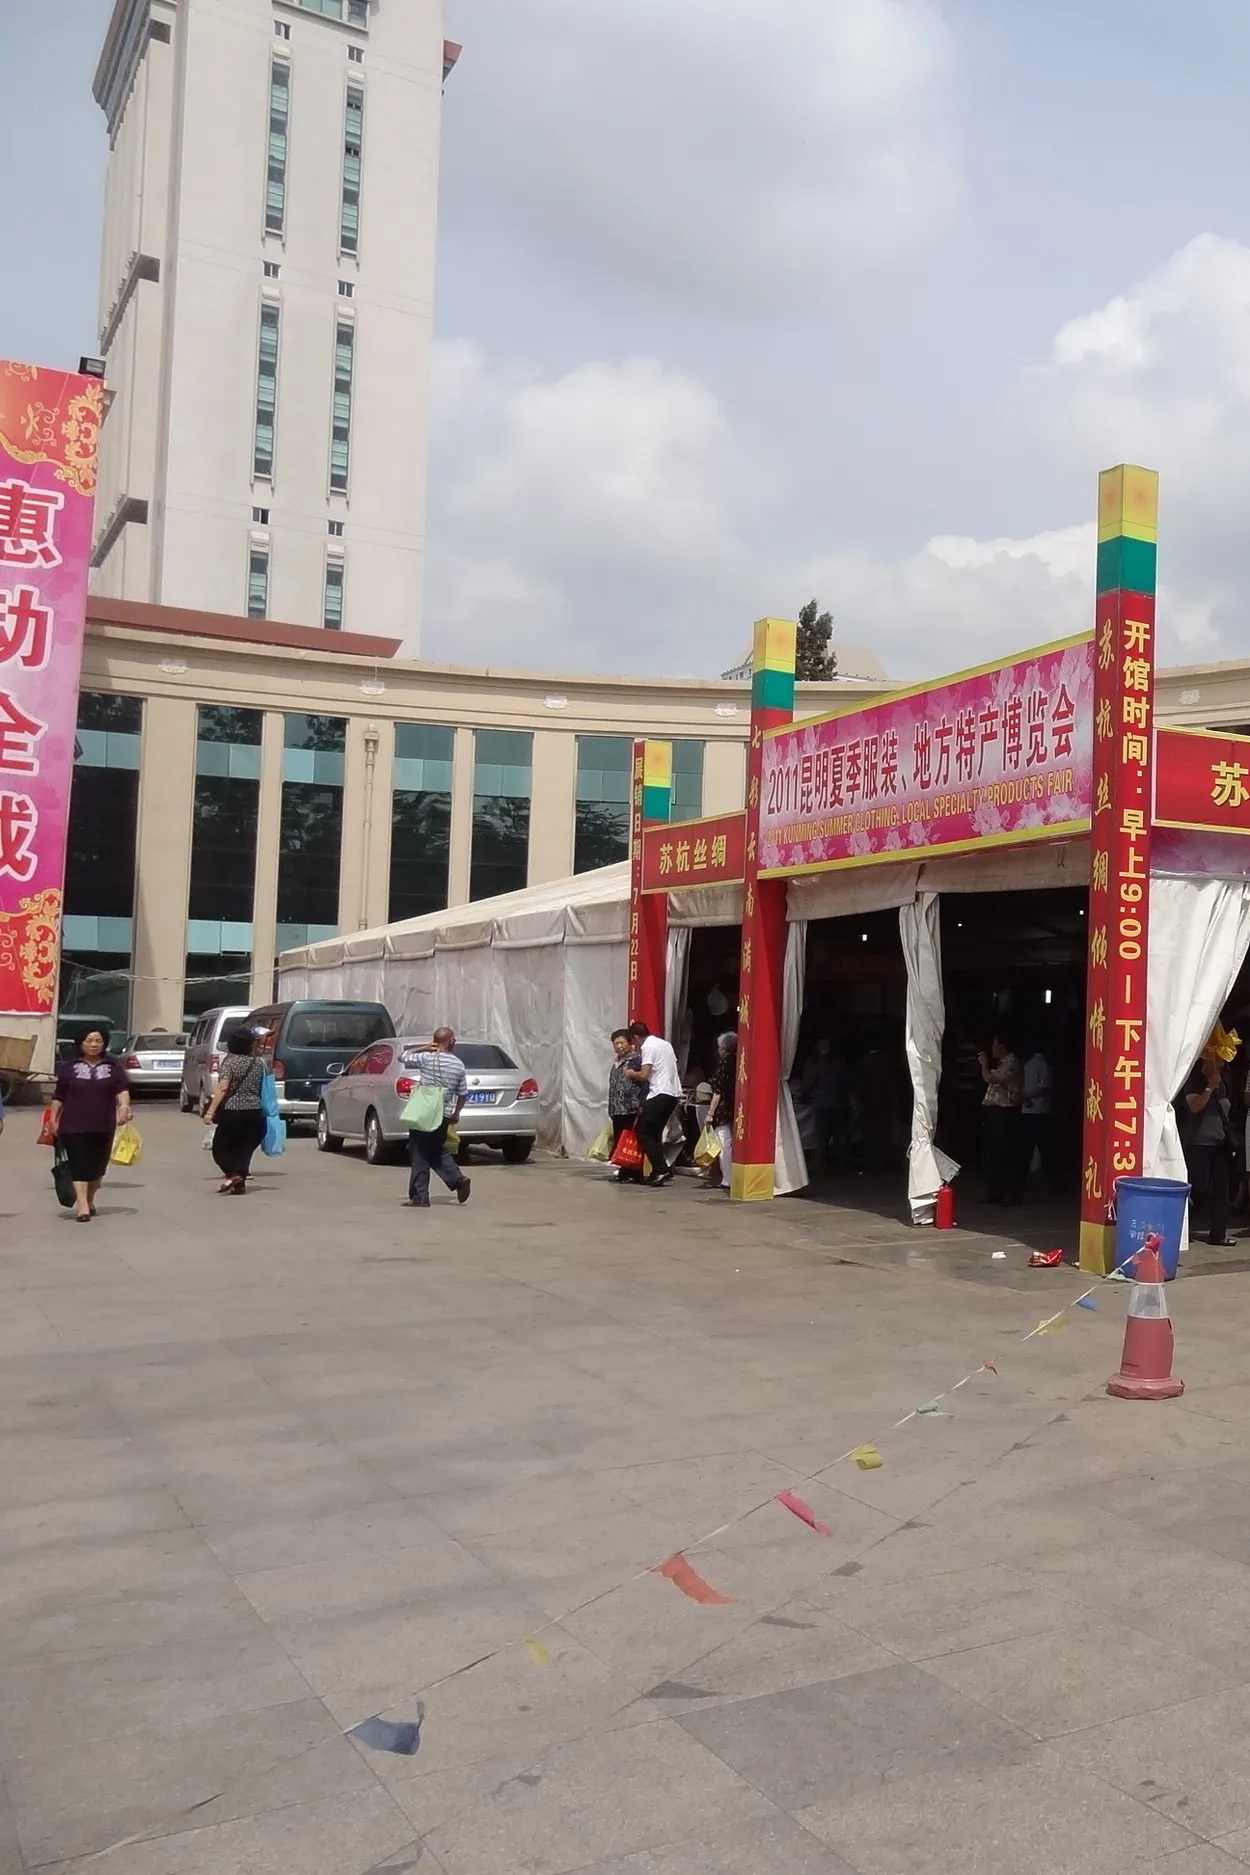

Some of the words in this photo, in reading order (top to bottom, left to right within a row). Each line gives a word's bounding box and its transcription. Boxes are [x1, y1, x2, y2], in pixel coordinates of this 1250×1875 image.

[767, 684, 1075, 815] 2011昆明夏季服装、地方特产博览会
[783, 820, 818, 844] KUNMING
[819, 814, 853, 838] SUMMER
[902, 799, 931, 824] LOCAL
[933, 786, 985, 818] SPECIALTY
[988, 773, 1043, 806] PRODUCTS
[1047, 767, 1073, 796] FAIR
[659, 834, 727, 874] 苏杭丝绸
